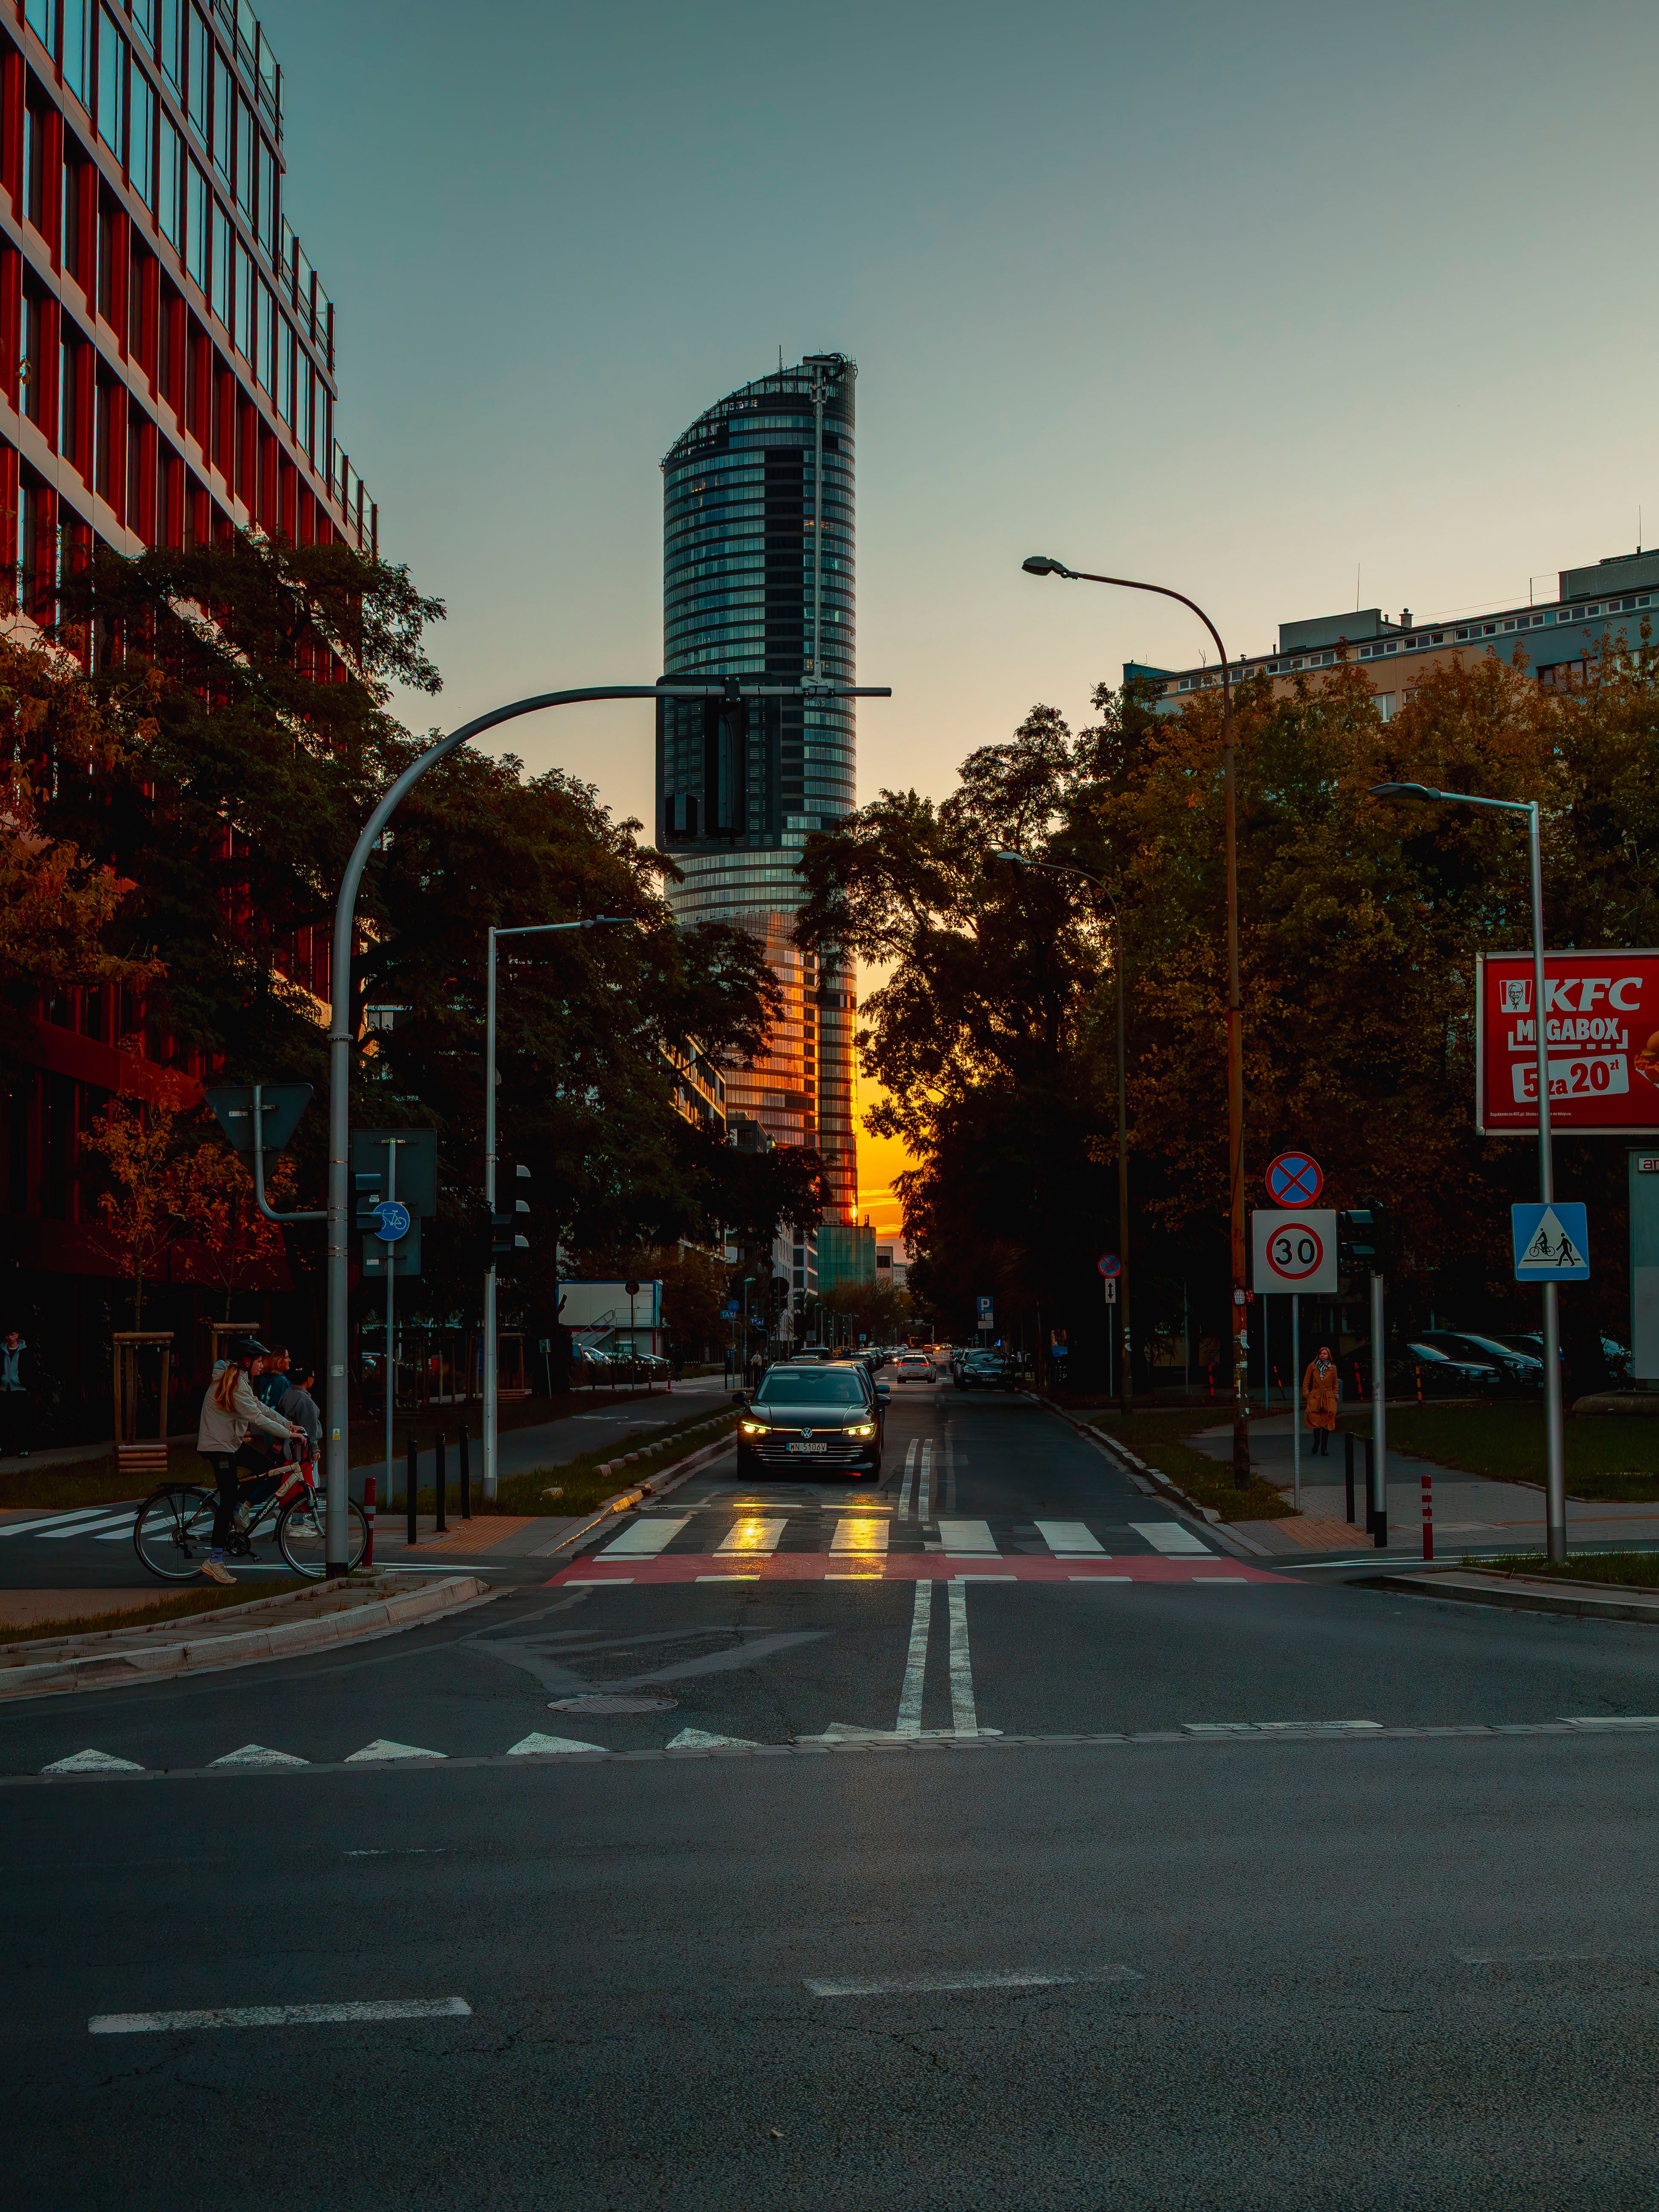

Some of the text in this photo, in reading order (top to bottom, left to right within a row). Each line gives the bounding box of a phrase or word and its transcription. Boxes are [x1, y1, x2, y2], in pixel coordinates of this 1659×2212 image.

[1544, 978, 1643, 1012] KFC
[1517, 1018, 1620, 1041] MGABOX
[1570, 1060, 1610, 1093] 20
[1275, 1238, 1315, 1265] 30
[981, 1298, 990, 1311] P
